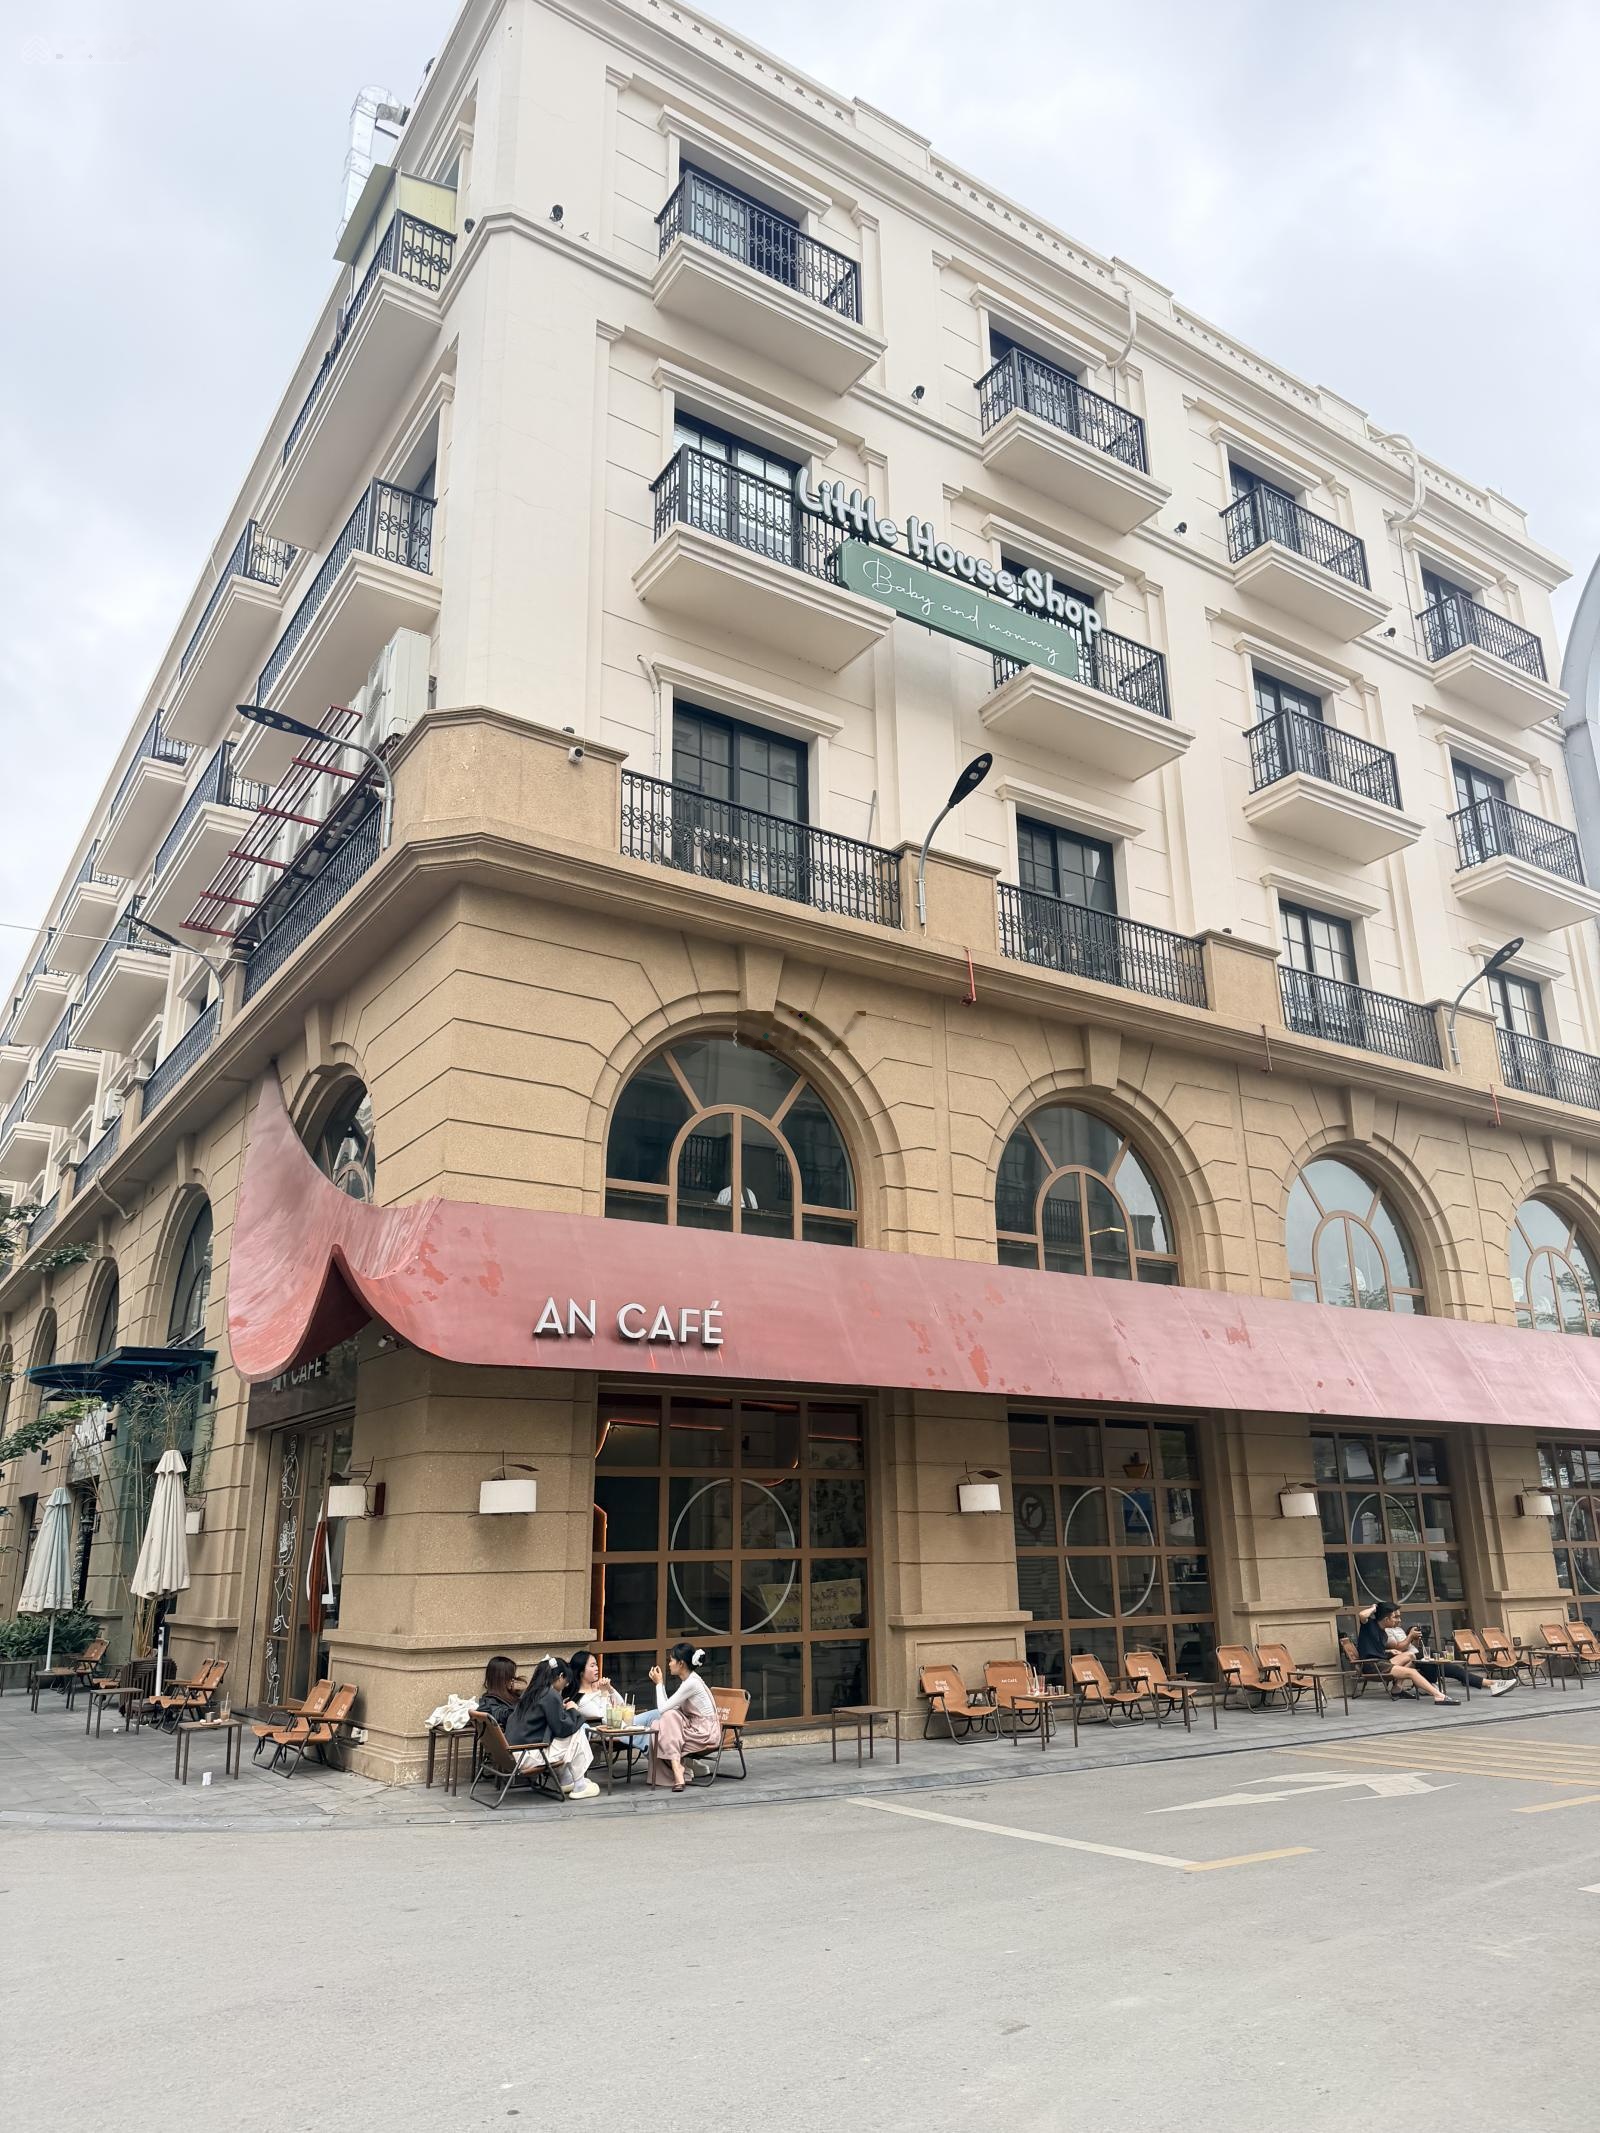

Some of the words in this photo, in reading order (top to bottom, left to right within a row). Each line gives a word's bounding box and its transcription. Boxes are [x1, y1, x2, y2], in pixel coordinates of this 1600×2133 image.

[795, 467, 898, 548] Little
[907, 515, 1017, 599] House
[1021, 567, 1102, 645] Shop
[862, 558, 936, 615] Baby
[942, 605, 979, 631] and
[989, 623, 1060, 666] mommy
[532, 1297, 596, 1335] AN
[616, 1300, 724, 1344] CAFÉ
